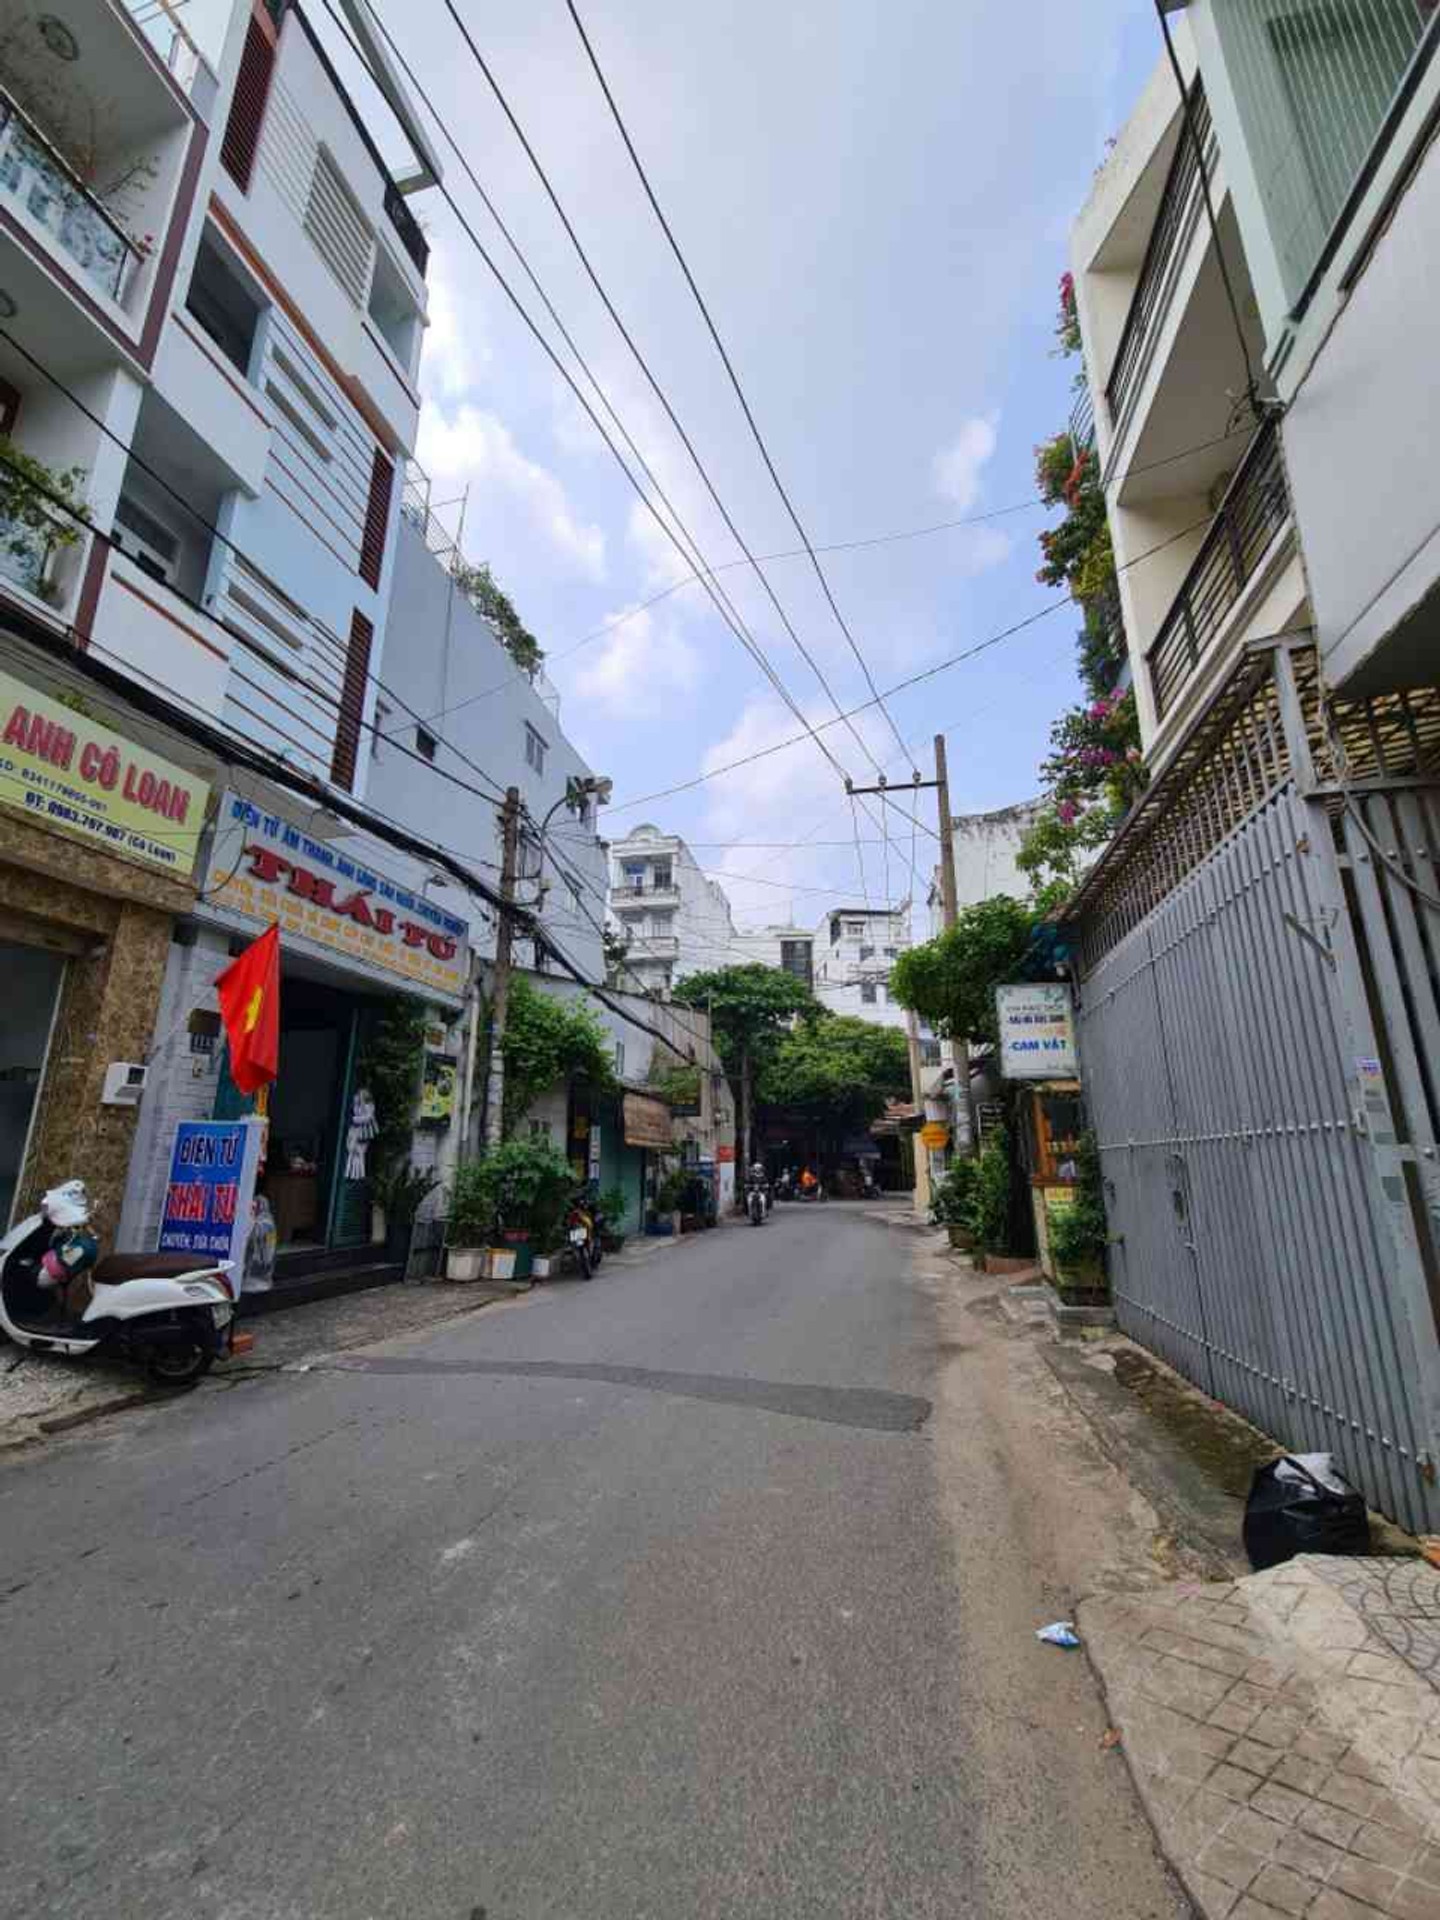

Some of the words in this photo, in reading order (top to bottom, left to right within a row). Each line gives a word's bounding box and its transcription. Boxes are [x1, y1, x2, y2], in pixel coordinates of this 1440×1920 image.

[3, 705, 76, 771] ANH
[79, 742, 120, 791] CÔ
[122, 763, 191, 825] LOAN
[242, 844, 396, 936] THÁI
